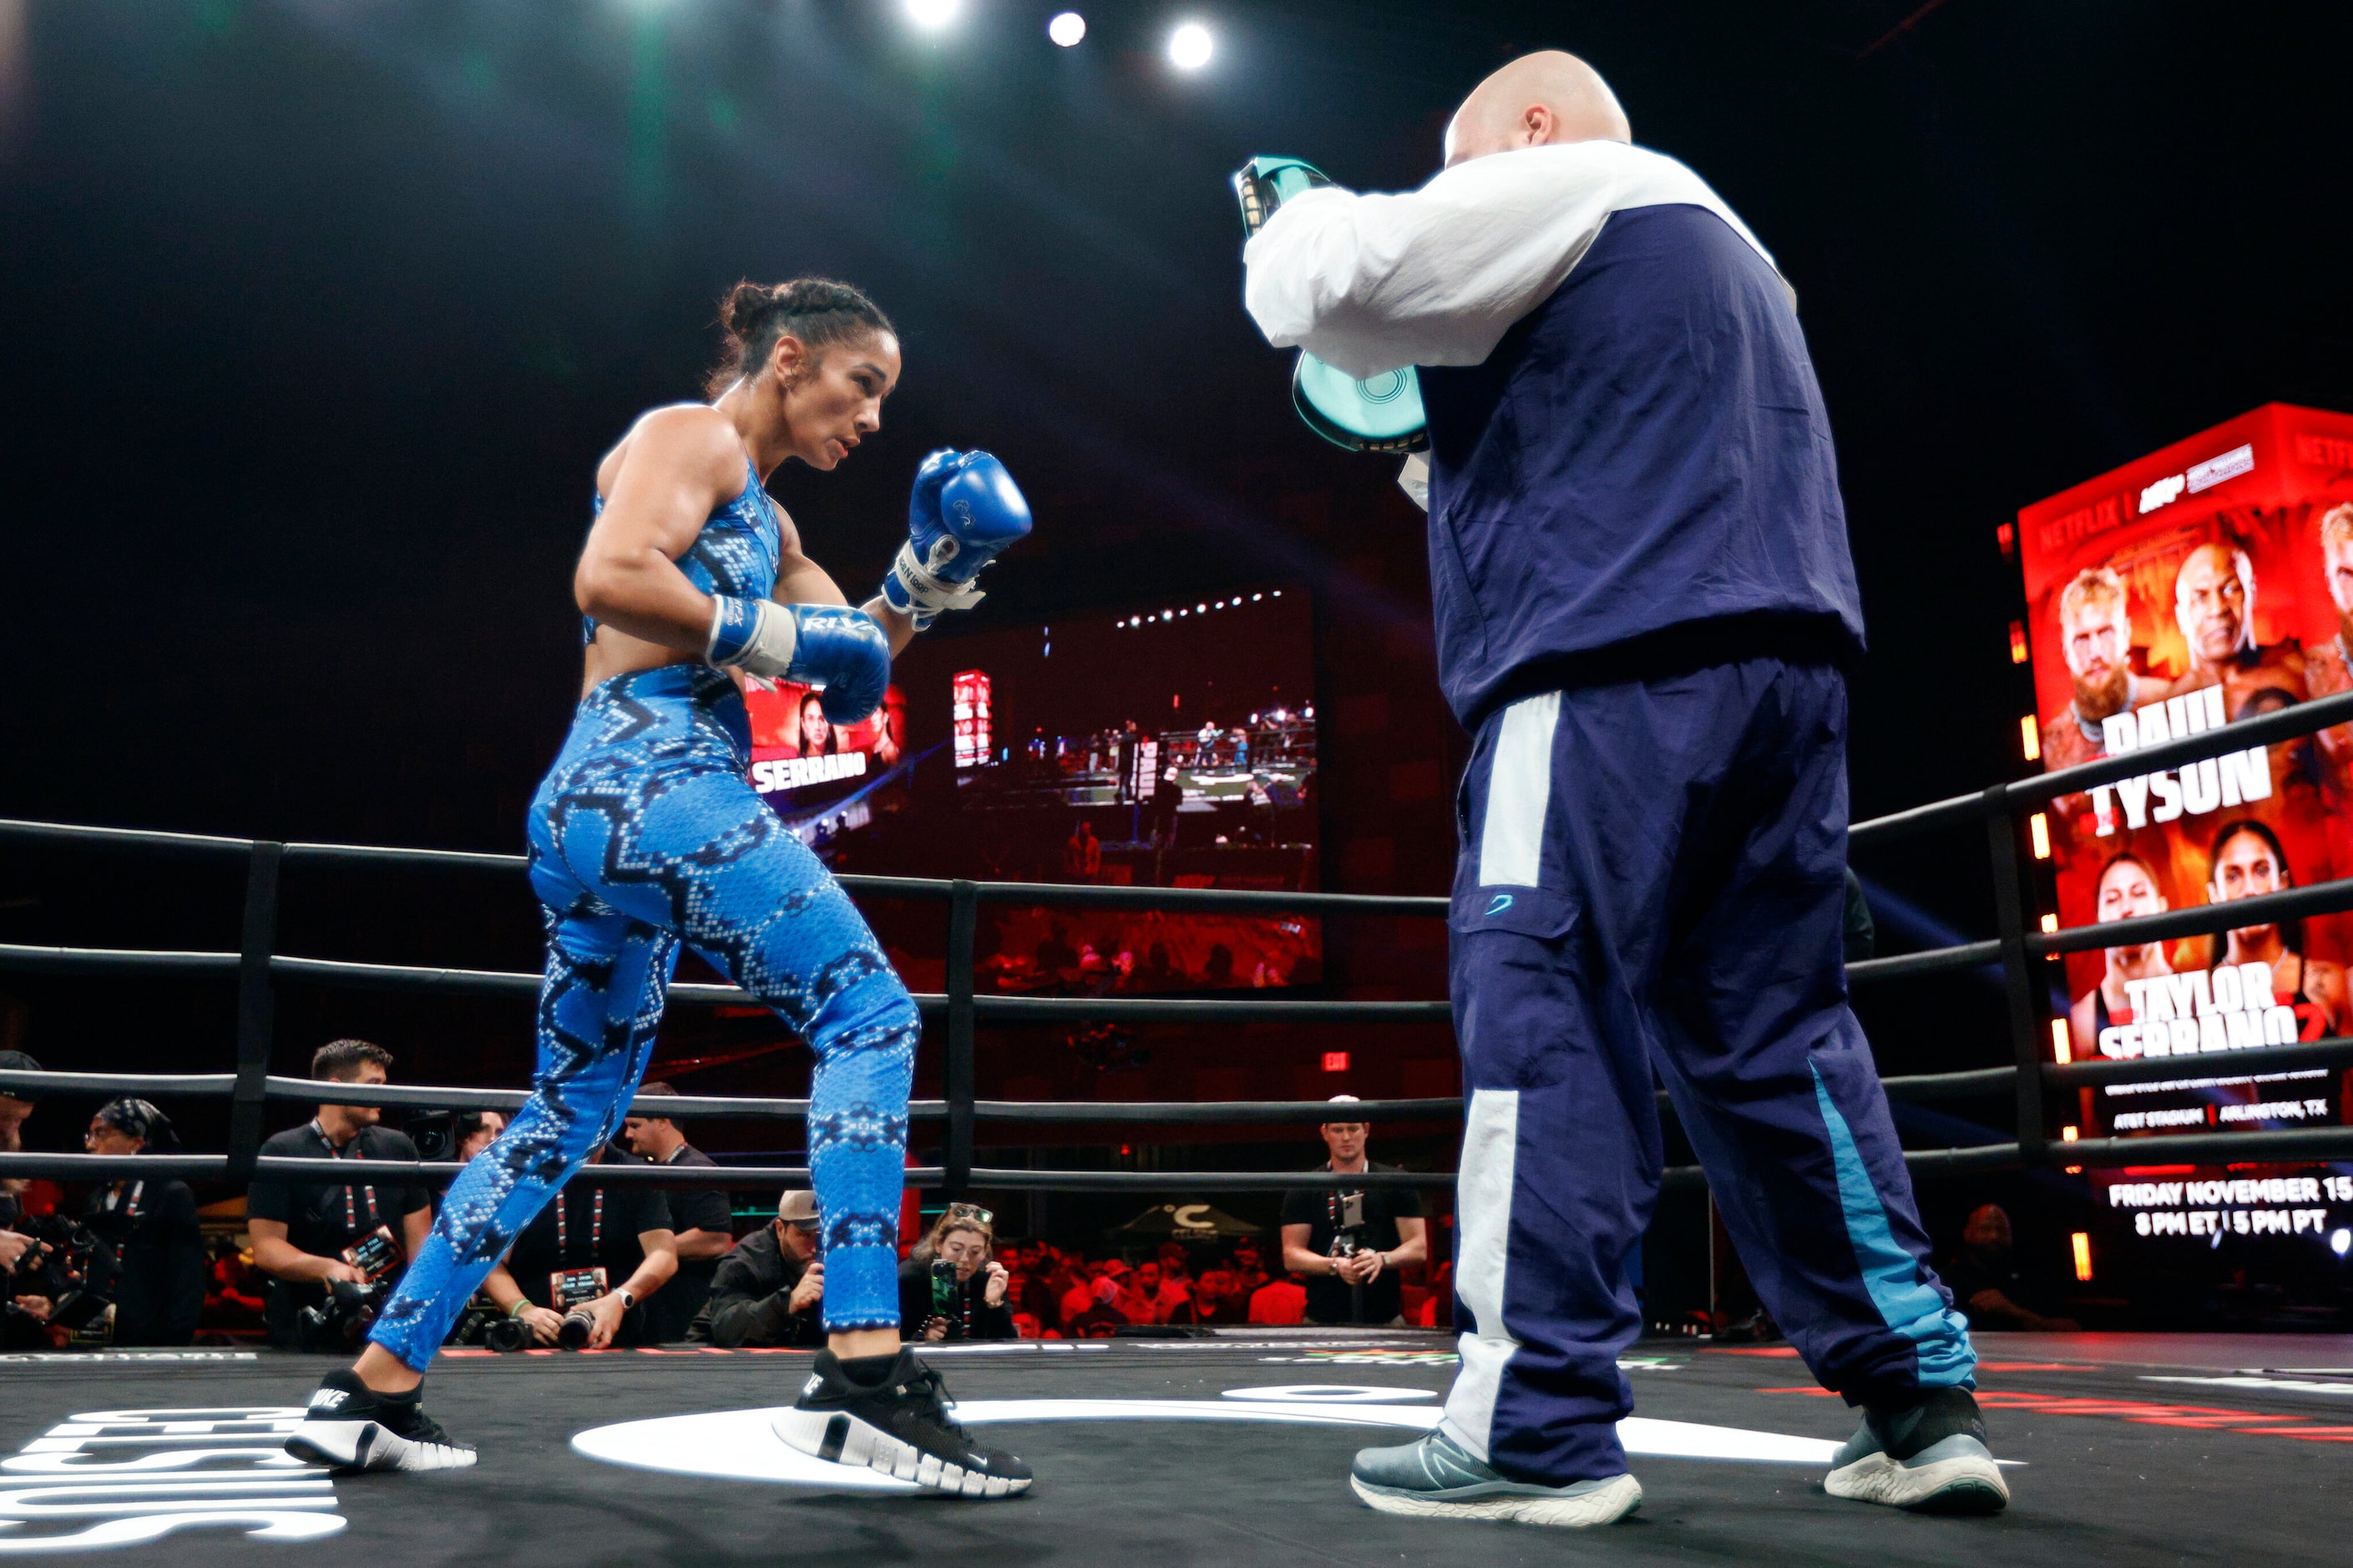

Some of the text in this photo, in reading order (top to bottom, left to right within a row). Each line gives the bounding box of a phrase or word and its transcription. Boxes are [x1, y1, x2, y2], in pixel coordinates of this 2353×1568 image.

[752, 751, 867, 794] SERRANO
[1138, 741, 1158, 801] PAUL
[2084, 745, 2273, 837] TYSON
[2123, 961, 2277, 1024] TAYLOR
[2098, 1004, 2298, 1060] SERRANO
[2146, 1108, 2205, 1128] STADIUM
[2303, 1098, 2329, 1117] TX
[2108, 1176, 2353, 1208] FRIDAY NOVEMBER 15
[2291, 1208, 2328, 1234] PT
